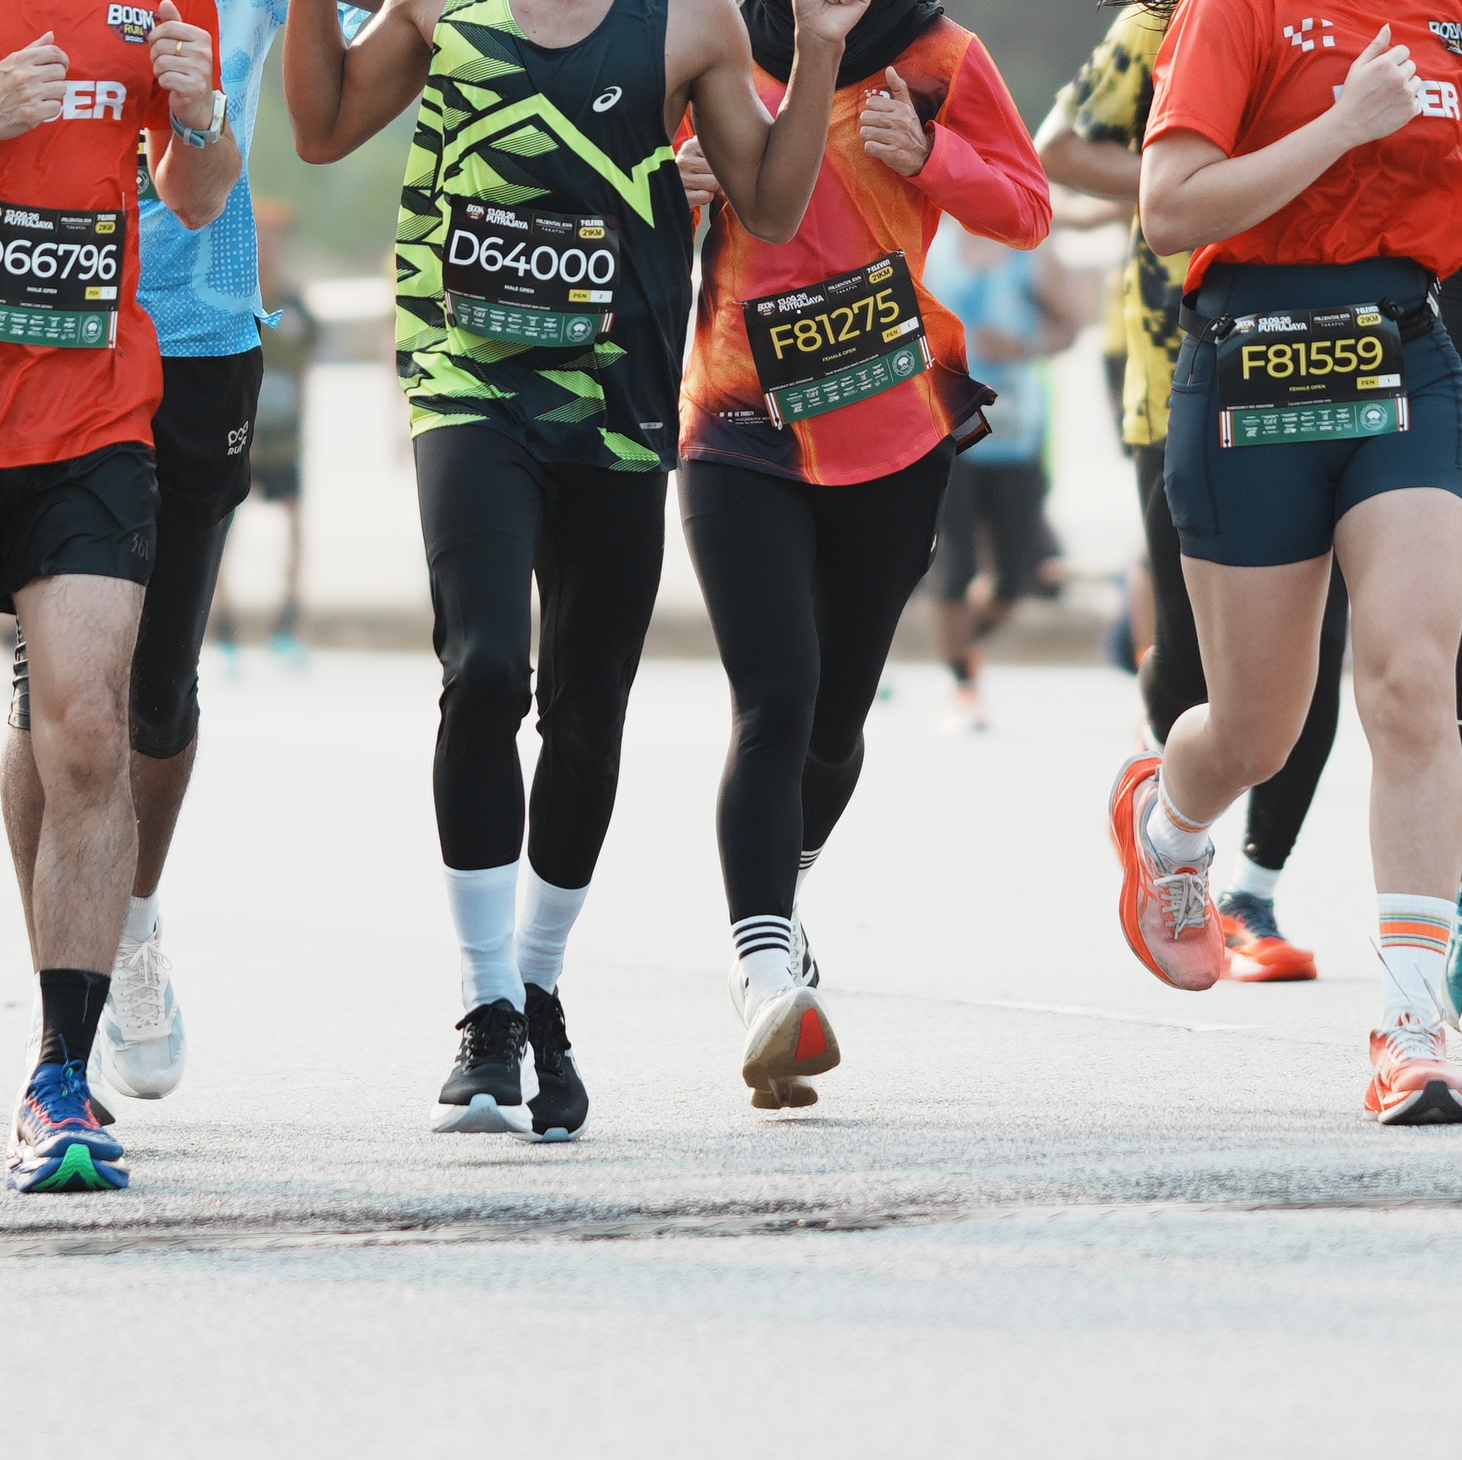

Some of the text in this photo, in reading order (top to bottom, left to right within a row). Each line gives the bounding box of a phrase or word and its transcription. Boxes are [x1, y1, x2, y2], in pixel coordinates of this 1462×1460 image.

[107, 3, 156, 29] BOOM
[123, 24, 144, 35] RUN
[5, 209, 39, 221] 13.09.26
[487, 208, 515, 220] 13.09.26
[4, 217, 54, 230] PUTRAJAYA
[486, 215, 529, 230] PUTRAJAYA
[449, 229, 615, 284] D64000
[872, 269, 890, 282] 21KM
[520, 286, 534, 294] OPEN
[777, 292, 807, 305] 13.09.26
[779, 295, 824, 313] PUTRAJAYA
[769, 288, 900, 359] F81275
[1258, 316, 1291, 324] 13.09.26
[1360, 315, 1378, 323] 21KM
[1258, 321, 1307, 333] PUTRAJAYA
[886, 329, 899, 339] PEN
[822, 347, 857, 362] FEMALE OPEN
[1242, 336, 1383, 380] F81559
